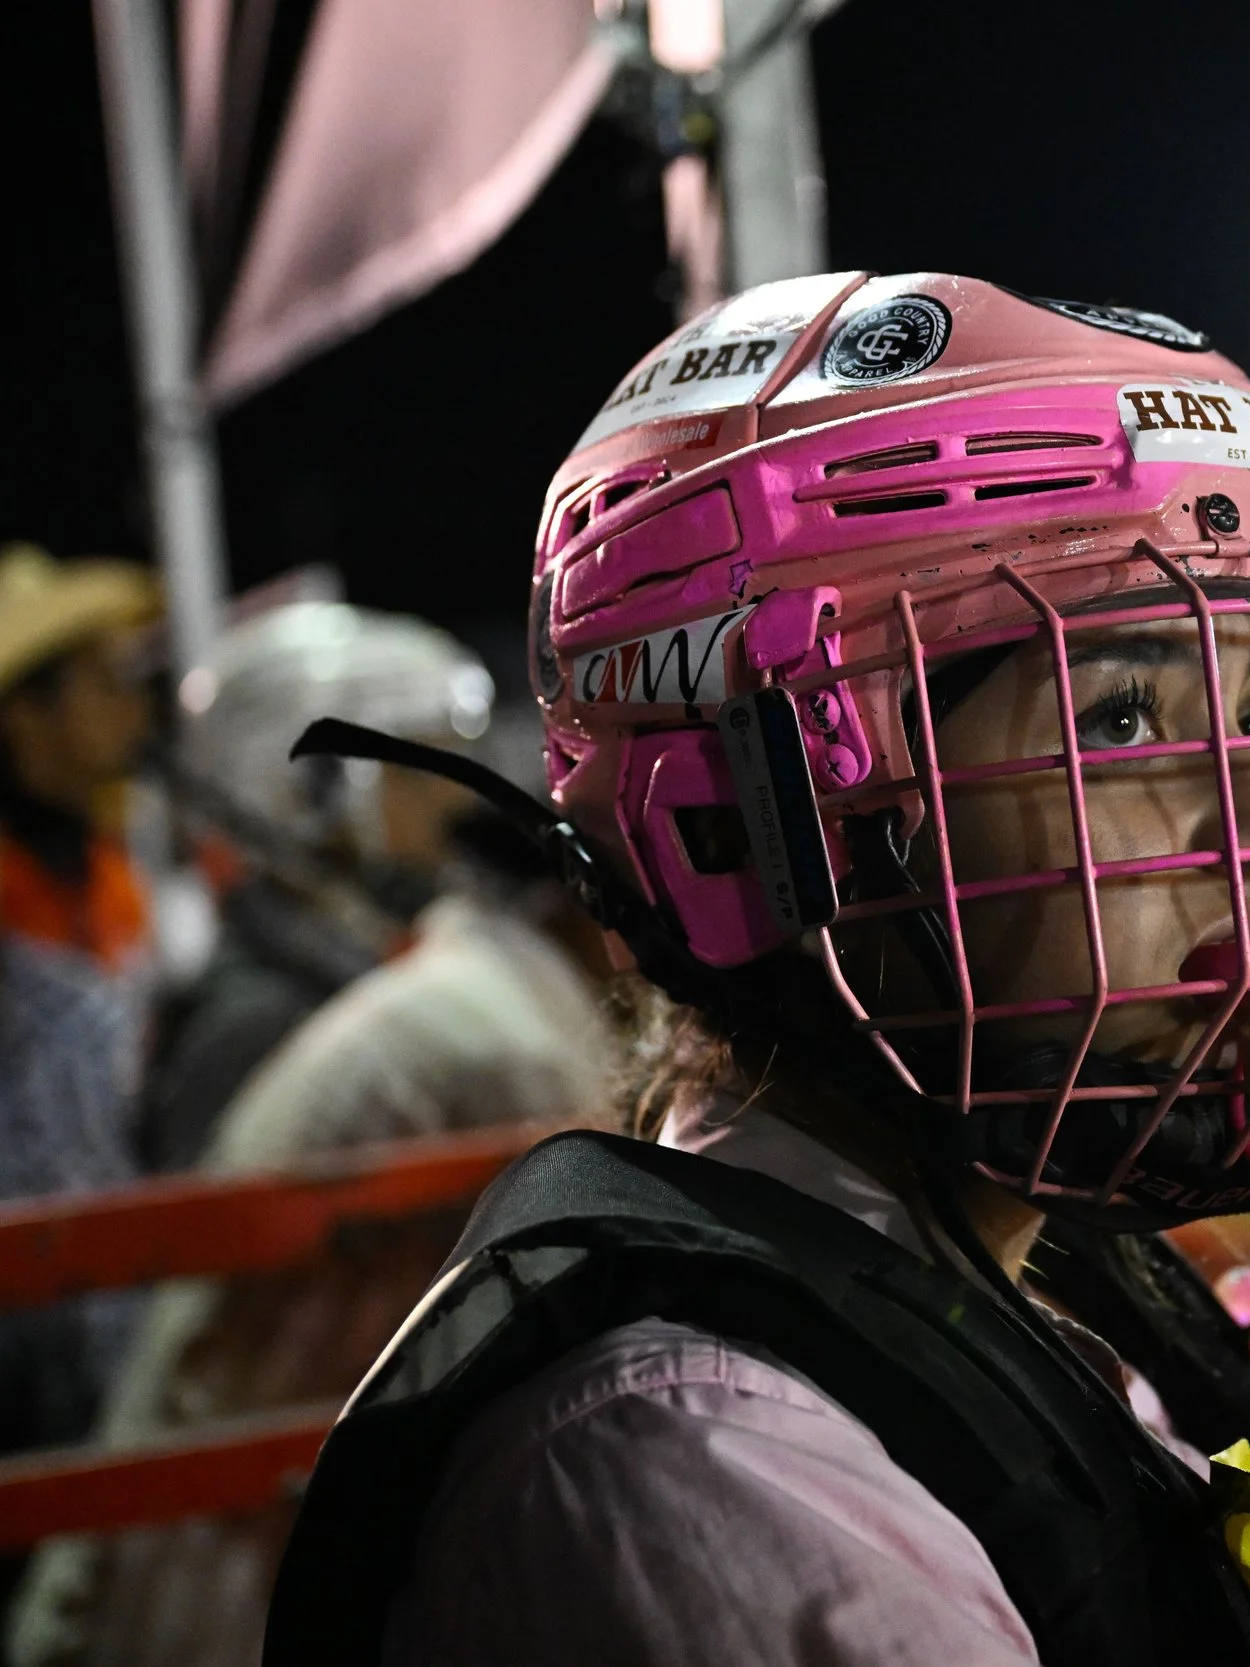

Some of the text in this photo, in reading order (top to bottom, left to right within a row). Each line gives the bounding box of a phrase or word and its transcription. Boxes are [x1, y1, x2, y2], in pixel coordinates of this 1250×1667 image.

[893, 306, 929, 346] COUNTRY
[669, 339, 778, 386] BAR
[1122, 390, 1238, 434] HAT
[1227, 447, 1247, 460] EST
